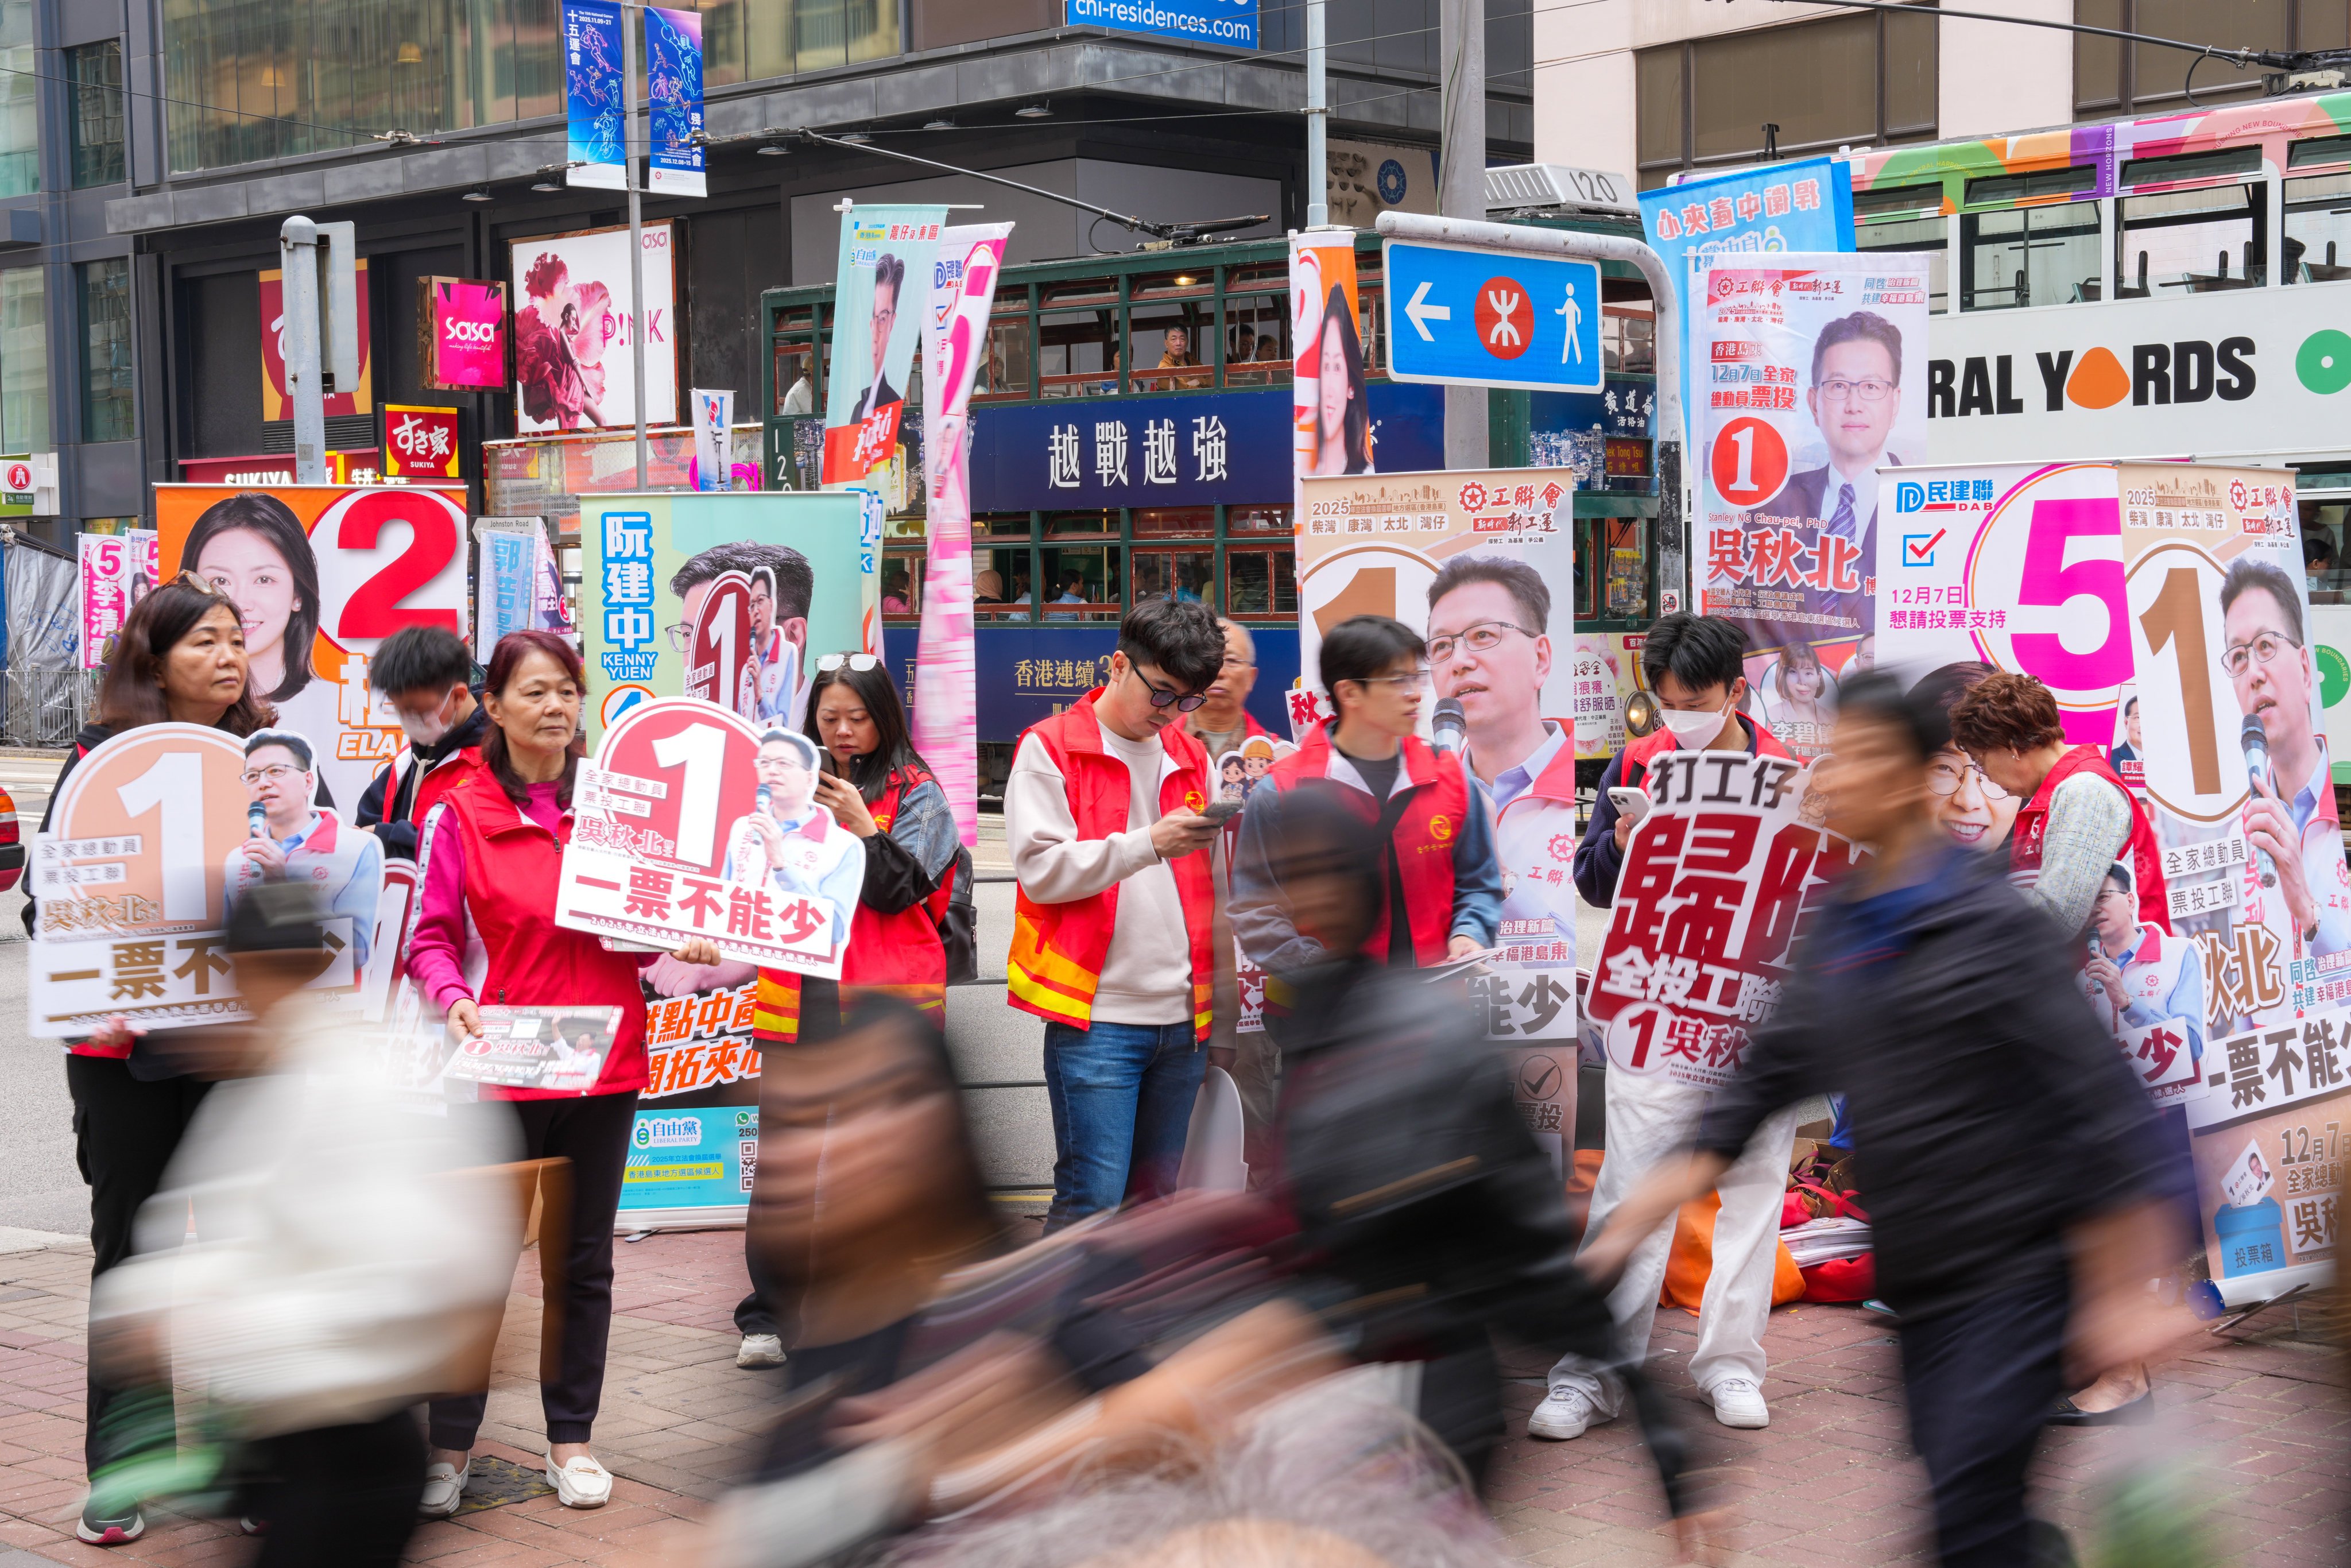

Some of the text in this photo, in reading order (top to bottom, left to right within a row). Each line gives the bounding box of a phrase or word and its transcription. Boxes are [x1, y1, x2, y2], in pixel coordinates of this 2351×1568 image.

[1075, 0, 1250, 40] chi-residences.com
[567, 10, 581, 66] 十五運會
[2213, 127, 2241, 150] PUSHING
[2242, 120, 2260, 130] NEW
[1569, 171, 1618, 203] 120
[889, 224, 939, 240] 灣仔及東區
[1736, 278, 1785, 297] 工聯會
[1861, 291, 1925, 304] 共建幸福港島東
[1714, 343, 1762, 357] 香港島東
[1710, 385, 1796, 411] 總動員票投
[1617, 416, 1645, 428] 活絡油
[393, 414, 450, 459] すき家
[1048, 415, 1227, 489] 越戰越強
[1617, 446, 1644, 459] Tong Tsui
[1729, 427, 1759, 491] 1
[225, 471, 293, 485] SUKIYA
[1606, 462, 1640, 473] 石塘咀
[1490, 482, 1565, 509] 工聯會
[1928, 479, 1993, 502] 民建聯
[2251, 485, 2294, 515] 工聯會
[1393, 502, 1447, 512] 地方選區(香港島東)
[1708, 512, 1828, 529] Stanley NG Chau-pei, PhD
[1959, 503, 1993, 511] DAB
[2129, 510, 2224, 529] 柴灣 康灣 太北 灣仔
[490, 520, 513, 528] Johnston
[1312, 516, 1445, 533] 柴灣 康灣 太北 灣仔
[1477, 519, 1504, 531] 新時代
[98, 544, 121, 576] 5
[145, 540, 158, 576] 5
[338, 490, 458, 639] 2
[1707, 528, 1860, 590] 吳秋北
[606, 516, 649, 648] 阮建中
[1892, 586, 1962, 605] 12月7日
[2011, 498, 2135, 691] 5
[1889, 609, 2006, 629] 懇請投票支持
[603, 654, 657, 667] KENNY
[707, 592, 737, 711] 1
[2321, 647, 2348, 682] BOUNDARIES
[610, 667, 650, 679] YUEN
[2139, 568, 2222, 795] 1
[1290, 691, 1327, 726] 秋
[2122, 761, 2144, 772] 譚耀
[584, 769, 665, 797] 全家總動員
[651, 722, 727, 868] 1
[1649, 757, 1799, 810] 打工仔
[583, 791, 648, 814] 票投工聯
[41, 838, 138, 859] 全家總動員
[117, 752, 207, 921] 1
[578, 815, 661, 855] 吳秋北
[2166, 839, 2245, 874] 全家總動員
[575, 865, 827, 944] 一票不能少
[2171, 881, 2233, 914] 票投工聯
[1499, 919, 1555, 935] 治理新篇
[1490, 941, 1569, 962] 幸福港島東
[1601, 944, 1784, 1025] 全投工聯
[470, 1042, 483, 1055] 1
[1628, 1008, 1659, 1070] 1
[1660, 1019, 1750, 1072] 吳秋
[2209, 1017, 2351, 1110] 一票不能
[653, 1121, 698, 1137] 自由黨
[652, 1153, 722, 1163] 2025年立法會換屆選舉
[628, 1167, 721, 1179] 香港島東地方選區候選人
[2287, 1159, 2348, 1194] 全家總動
[2229, 1186, 2236, 1197] 1
[2240, 1184, 2255, 1203] 吳秋北
[2234, 1242, 2273, 1269] 投票箱
